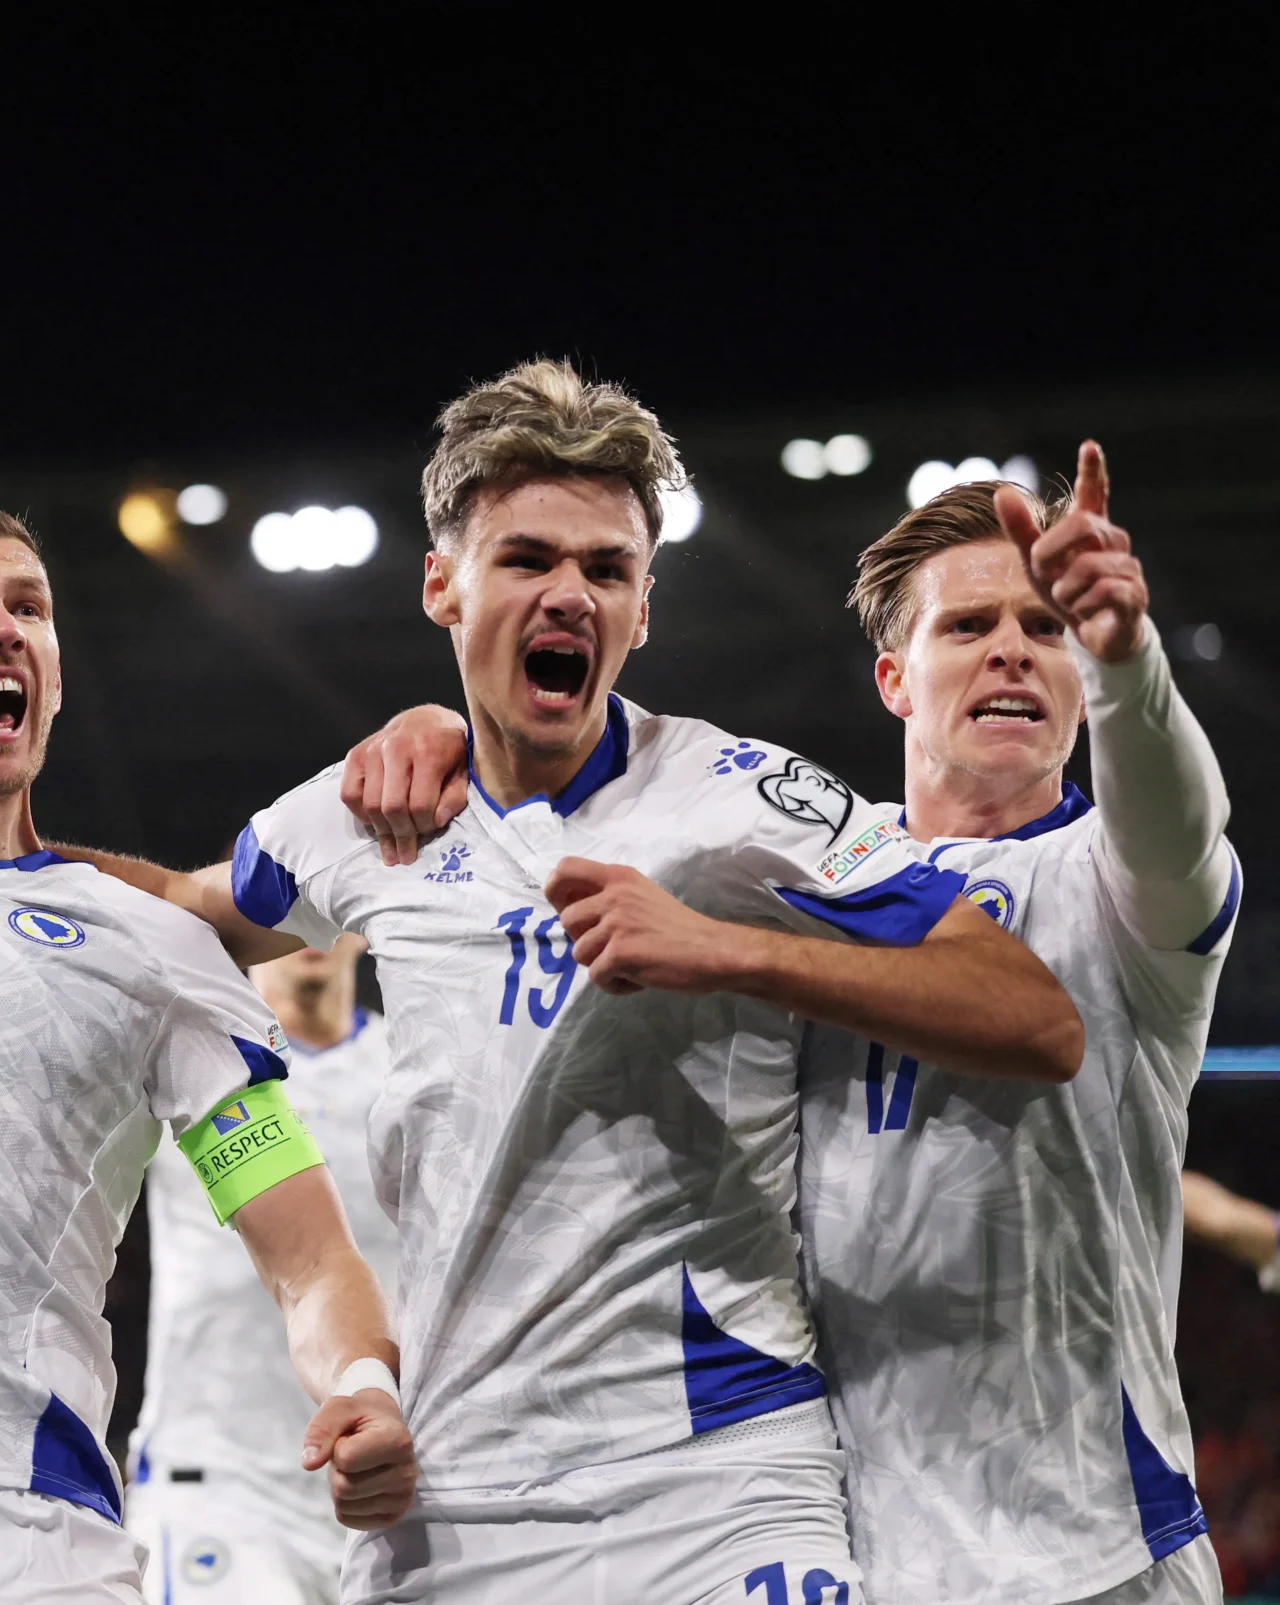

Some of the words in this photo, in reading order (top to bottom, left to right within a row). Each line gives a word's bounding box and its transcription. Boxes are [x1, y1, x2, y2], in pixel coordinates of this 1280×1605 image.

[423, 870, 475, 885] KELME
[824, 822, 901, 882] FOUNDATIO
[496, 906, 578, 1030] 19
[210, 1120, 285, 1173] RESPECT
